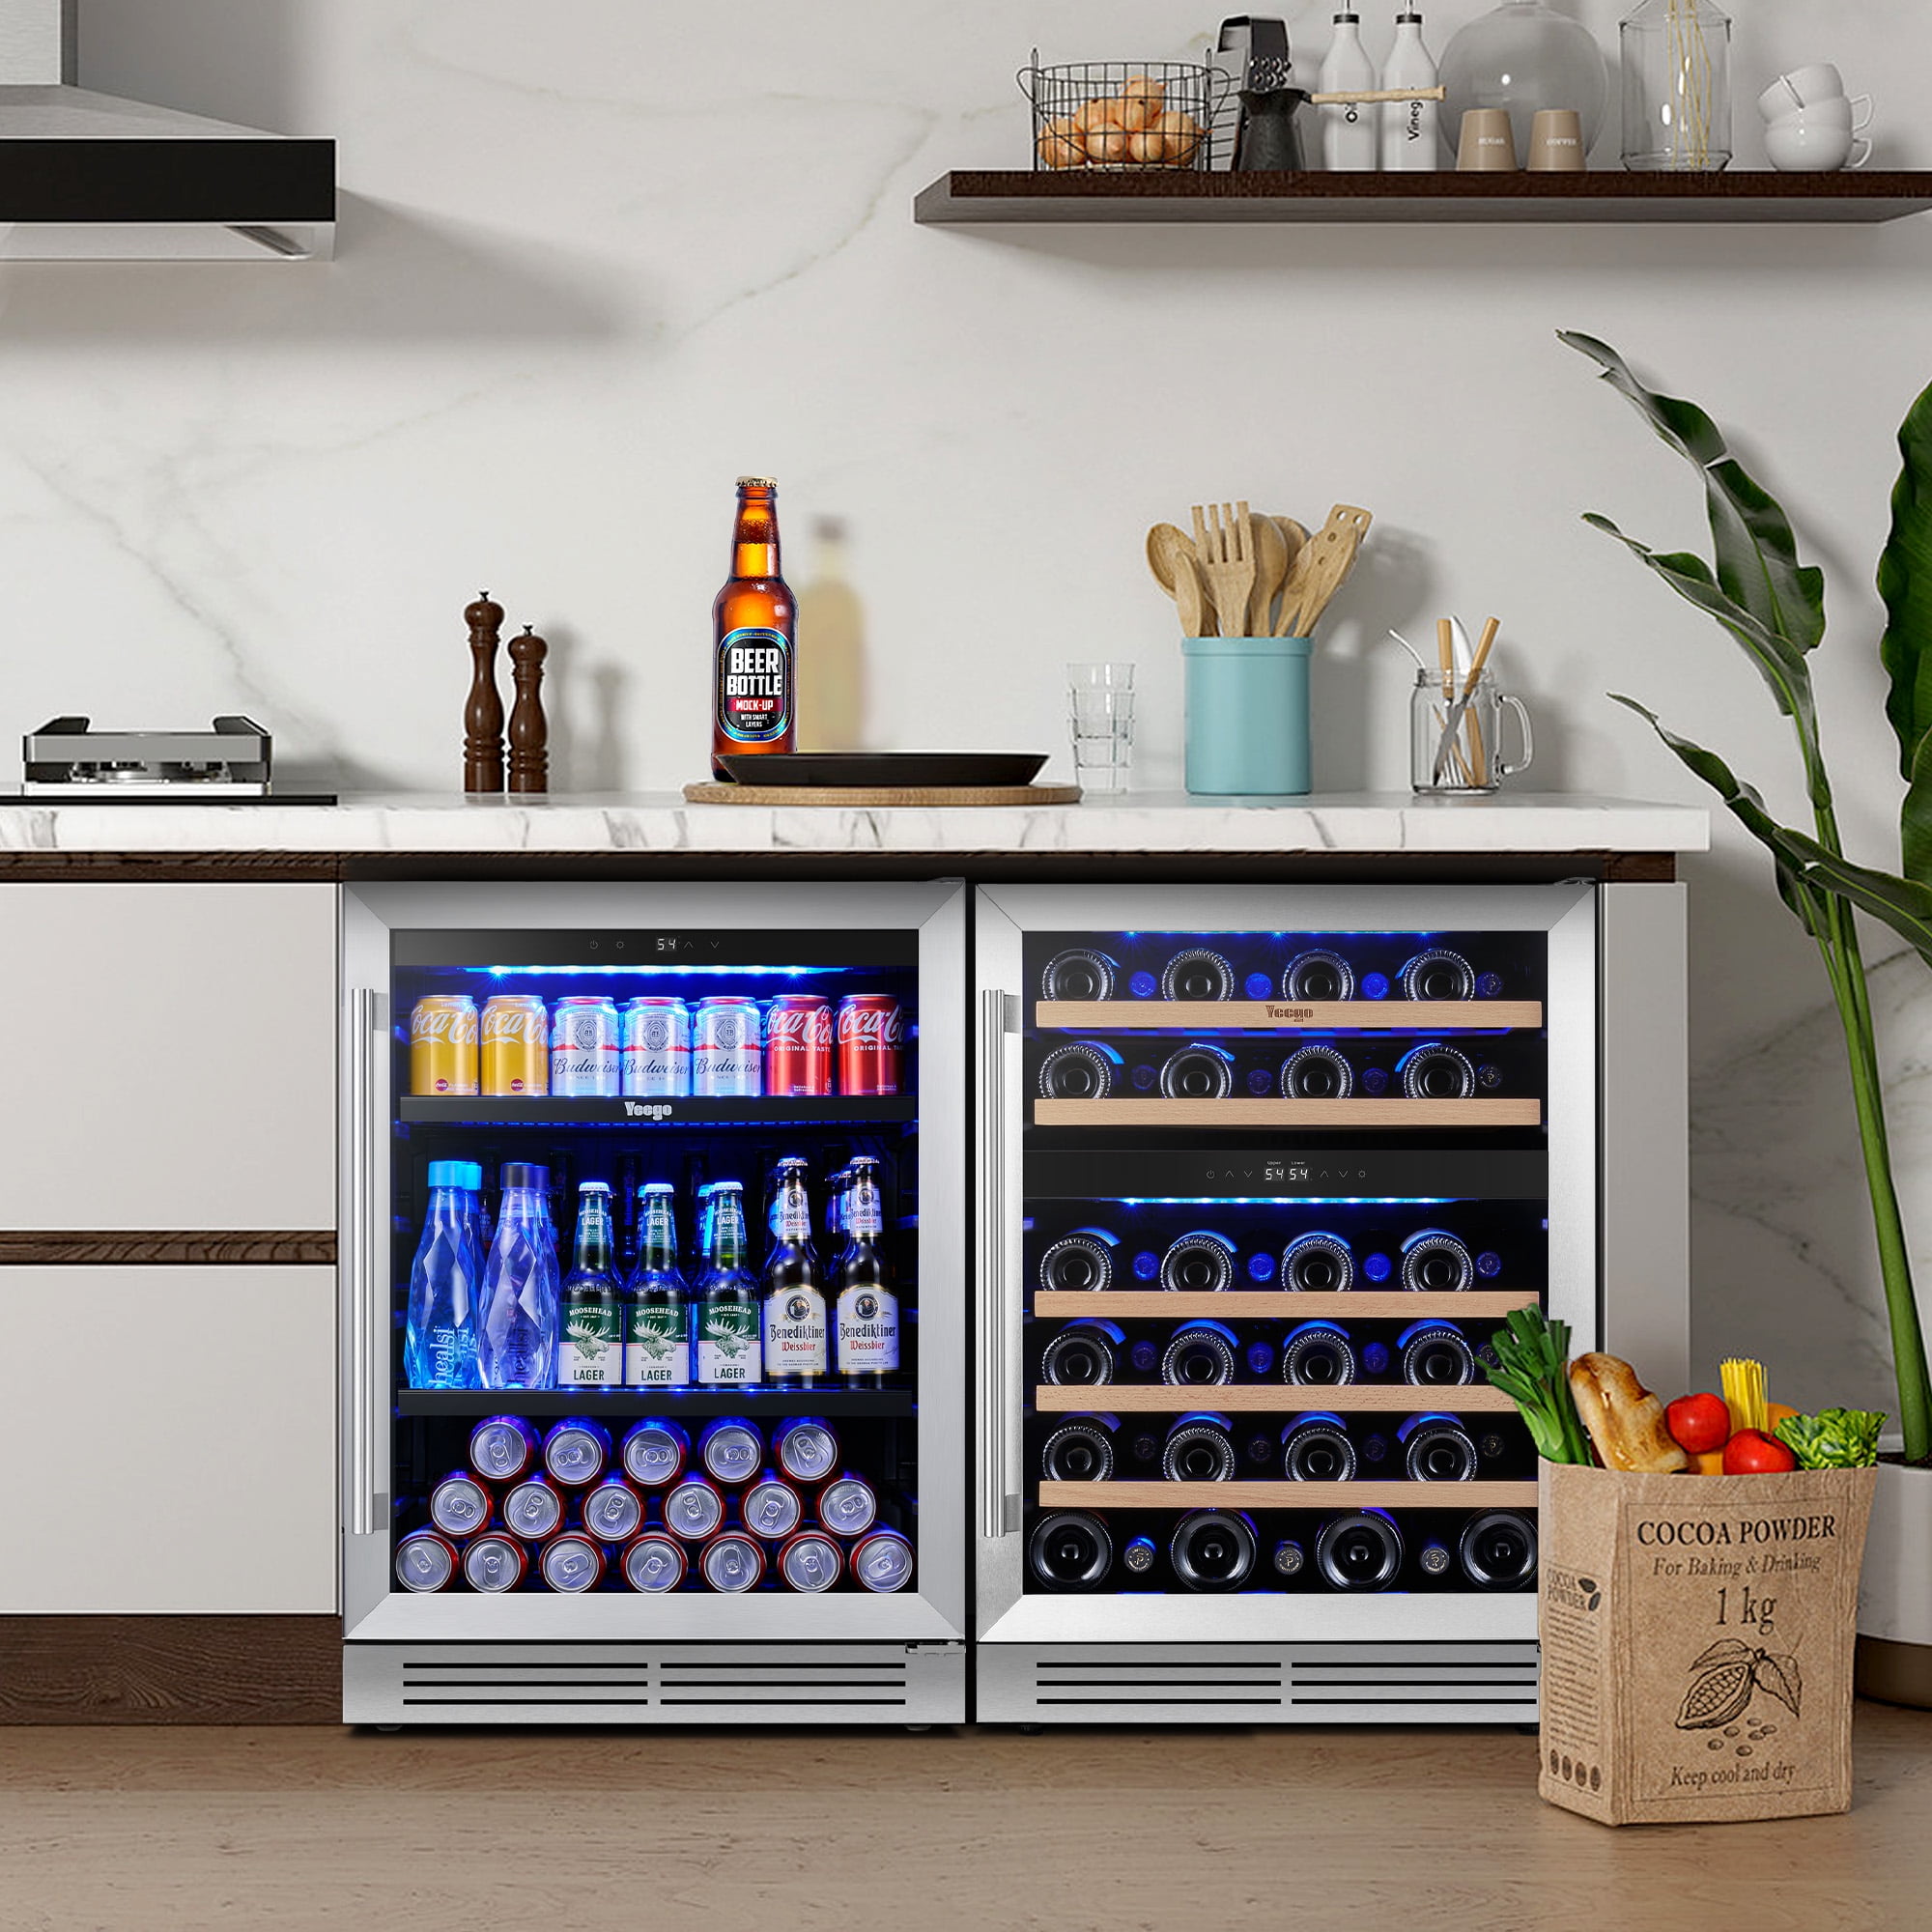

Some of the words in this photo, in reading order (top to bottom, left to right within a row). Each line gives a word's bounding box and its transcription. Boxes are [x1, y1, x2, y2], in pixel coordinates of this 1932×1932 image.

[1407, 88, 1423, 142] Vineg
[730, 648, 780, 674] BEER
[726, 675, 782, 696] BOTTLE
[735, 699, 774, 711] MOCK-UP
[741, 713, 752, 722] WITH
[752, 713, 769, 722] SMART
[774, 1044, 810, 1053] ORIGINAL
[624, 1101, 673, 1122] Yeego
[1264, 1168, 1284, 1180] 54
[1290, 1168, 1309, 1180] 54
[582, 1216, 605, 1226] LAGER
[646, 1216, 669, 1227] LAGER
[717, 1215, 740, 1225] LAGER
[568, 1306, 613, 1318] MOOSEHEAD
[635, 1307, 680, 1319] MOOSEHEAD
[708, 1305, 753, 1316] MOOSEHEAD
[769, 1323, 826, 1343] Benediktiner
[838, 1322, 896, 1341] Benediktiner
[781, 1341, 817, 1352] Weissbier
[849, 1340, 886, 1351] Weissbier
[573, 1369, 605, 1381] LAGER
[640, 1369, 672, 1381] LAGER
[714, 1367, 746, 1379] LAGER
[1637, 1520, 1731, 1546] COCOA
[1739, 1515, 1836, 1545] POWDER
[1653, 1556, 1682, 1576] For
[1688, 1556, 1743, 1579] Baking
[1746, 1555, 1759, 1575] &
[1761, 1552, 1823, 1575] Drinking
[1716, 1586, 1727, 1625] 1
[1740, 1585, 1777, 1635] kg
[1671, 1765, 1708, 1792] Keep
[1711, 1764, 1741, 1784] cool
[1742, 1761, 1773, 1783] and
[1774, 1761, 1797, 1785] dry
